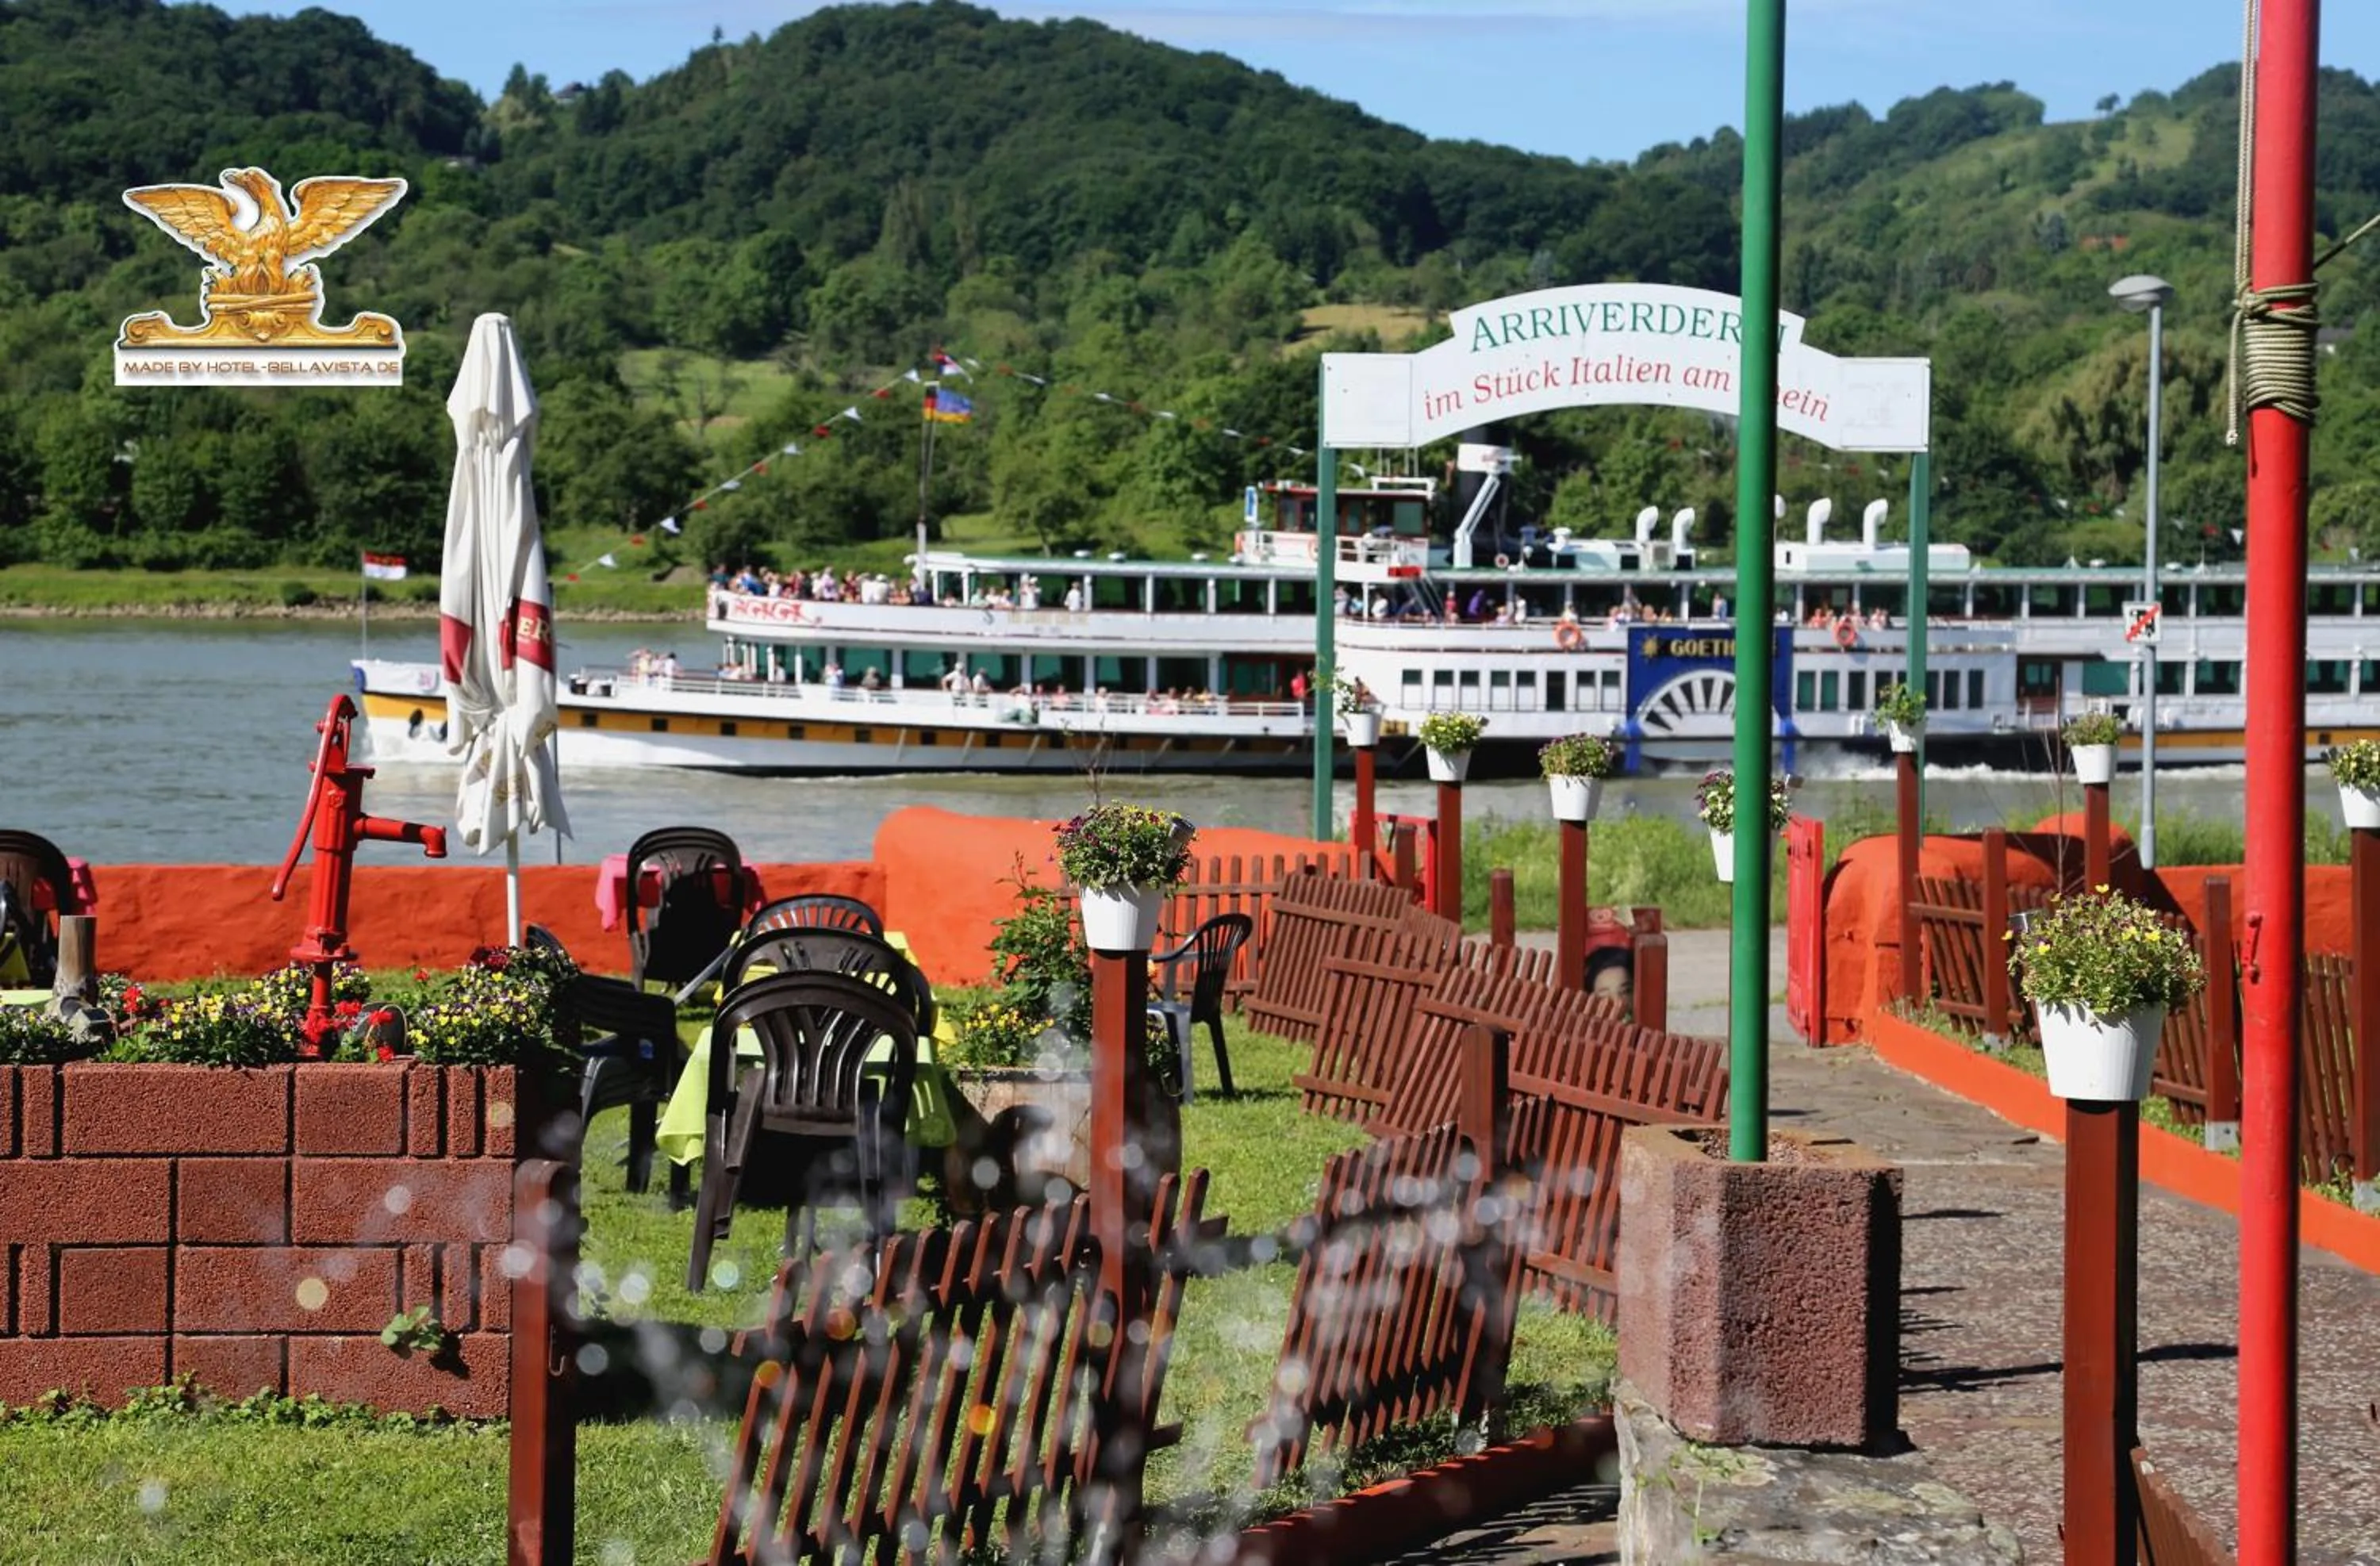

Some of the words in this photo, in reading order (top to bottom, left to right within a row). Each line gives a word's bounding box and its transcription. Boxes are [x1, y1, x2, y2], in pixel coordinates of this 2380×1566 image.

[1471, 301, 1788, 355] ARRIVERDERI
[1424, 390, 1463, 420] im
[1473, 360, 1560, 403] Stück
[1570, 354, 1672, 386] Italien
[1683, 365, 1730, 393] am
[1669, 638, 1737, 658] GOETH
